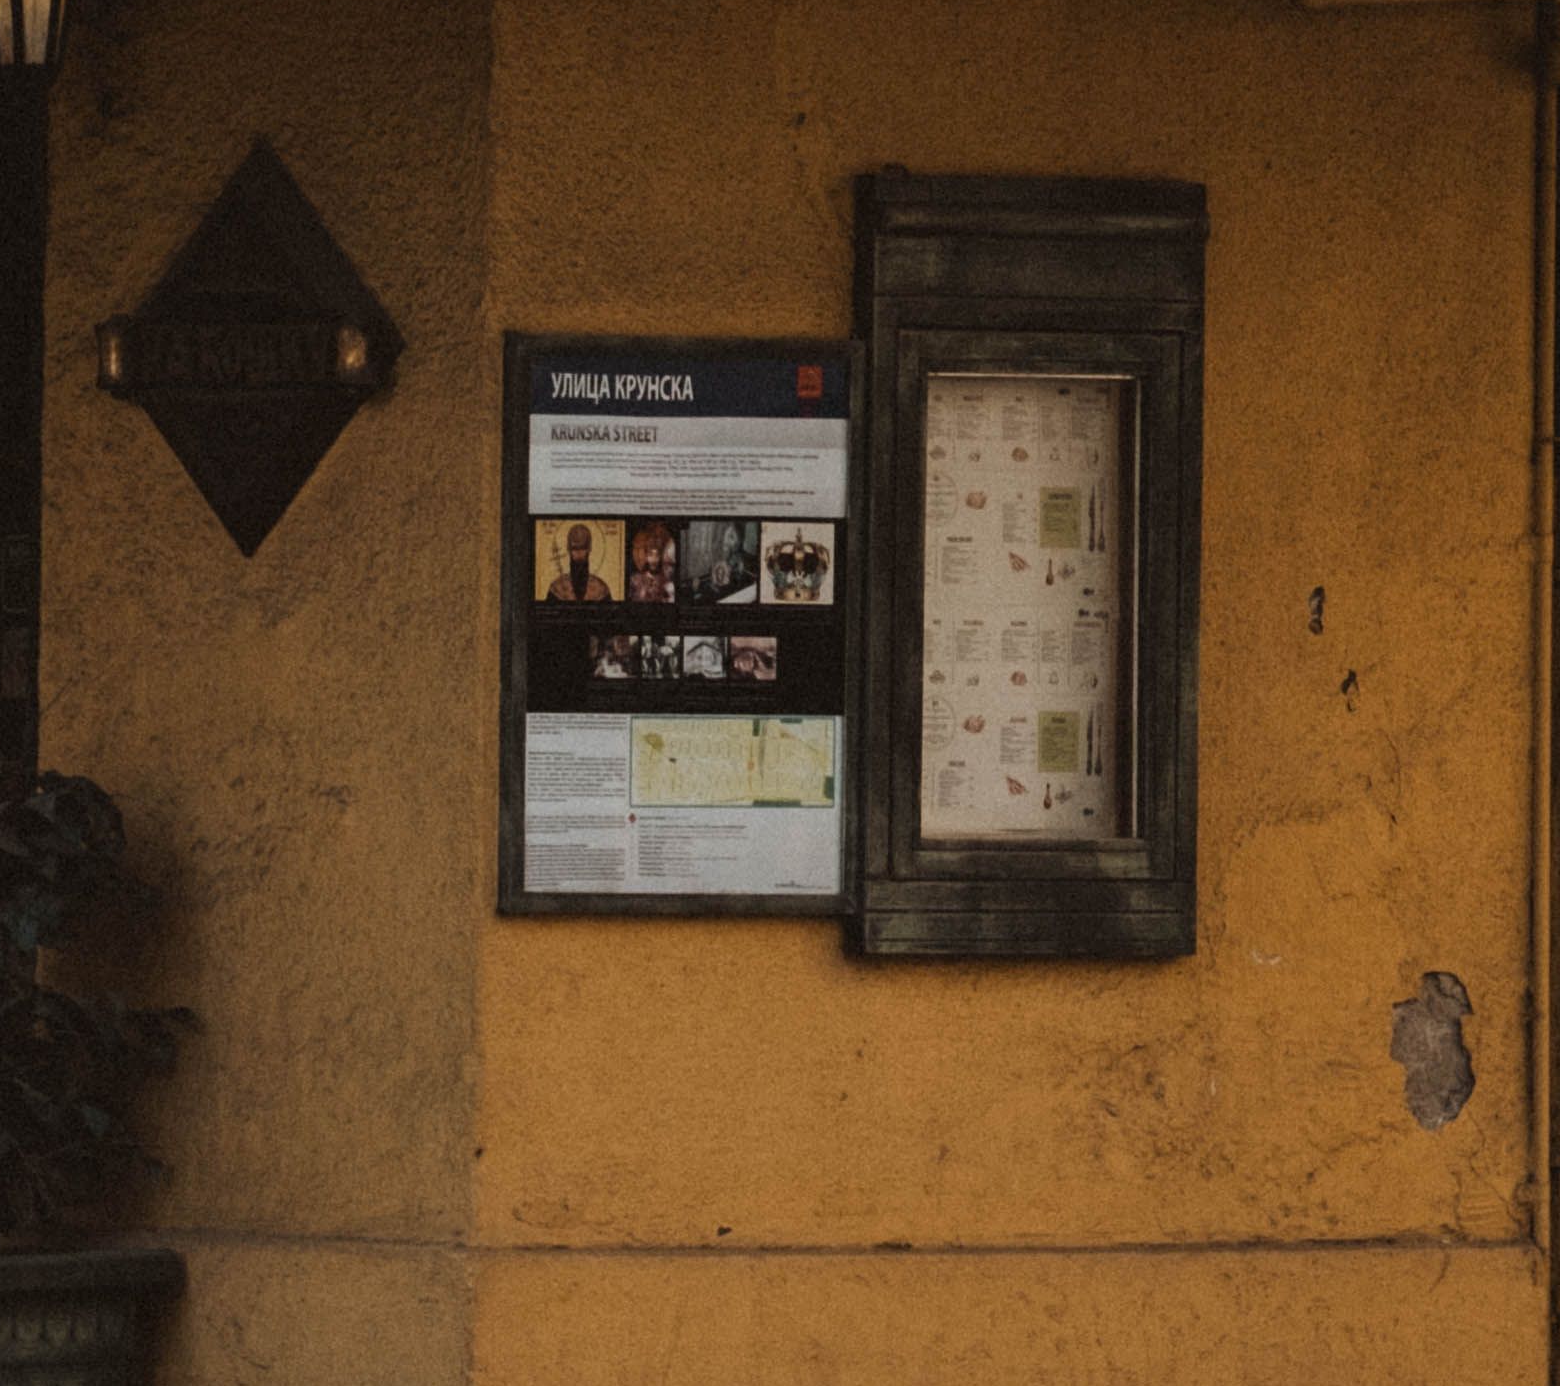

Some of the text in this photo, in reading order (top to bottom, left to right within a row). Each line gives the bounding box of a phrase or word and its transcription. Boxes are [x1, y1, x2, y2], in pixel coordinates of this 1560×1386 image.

[551, 372, 694, 404] УЛИЦА КРУНСКА
[551, 423, 658, 444] KRUNSKA STREET
